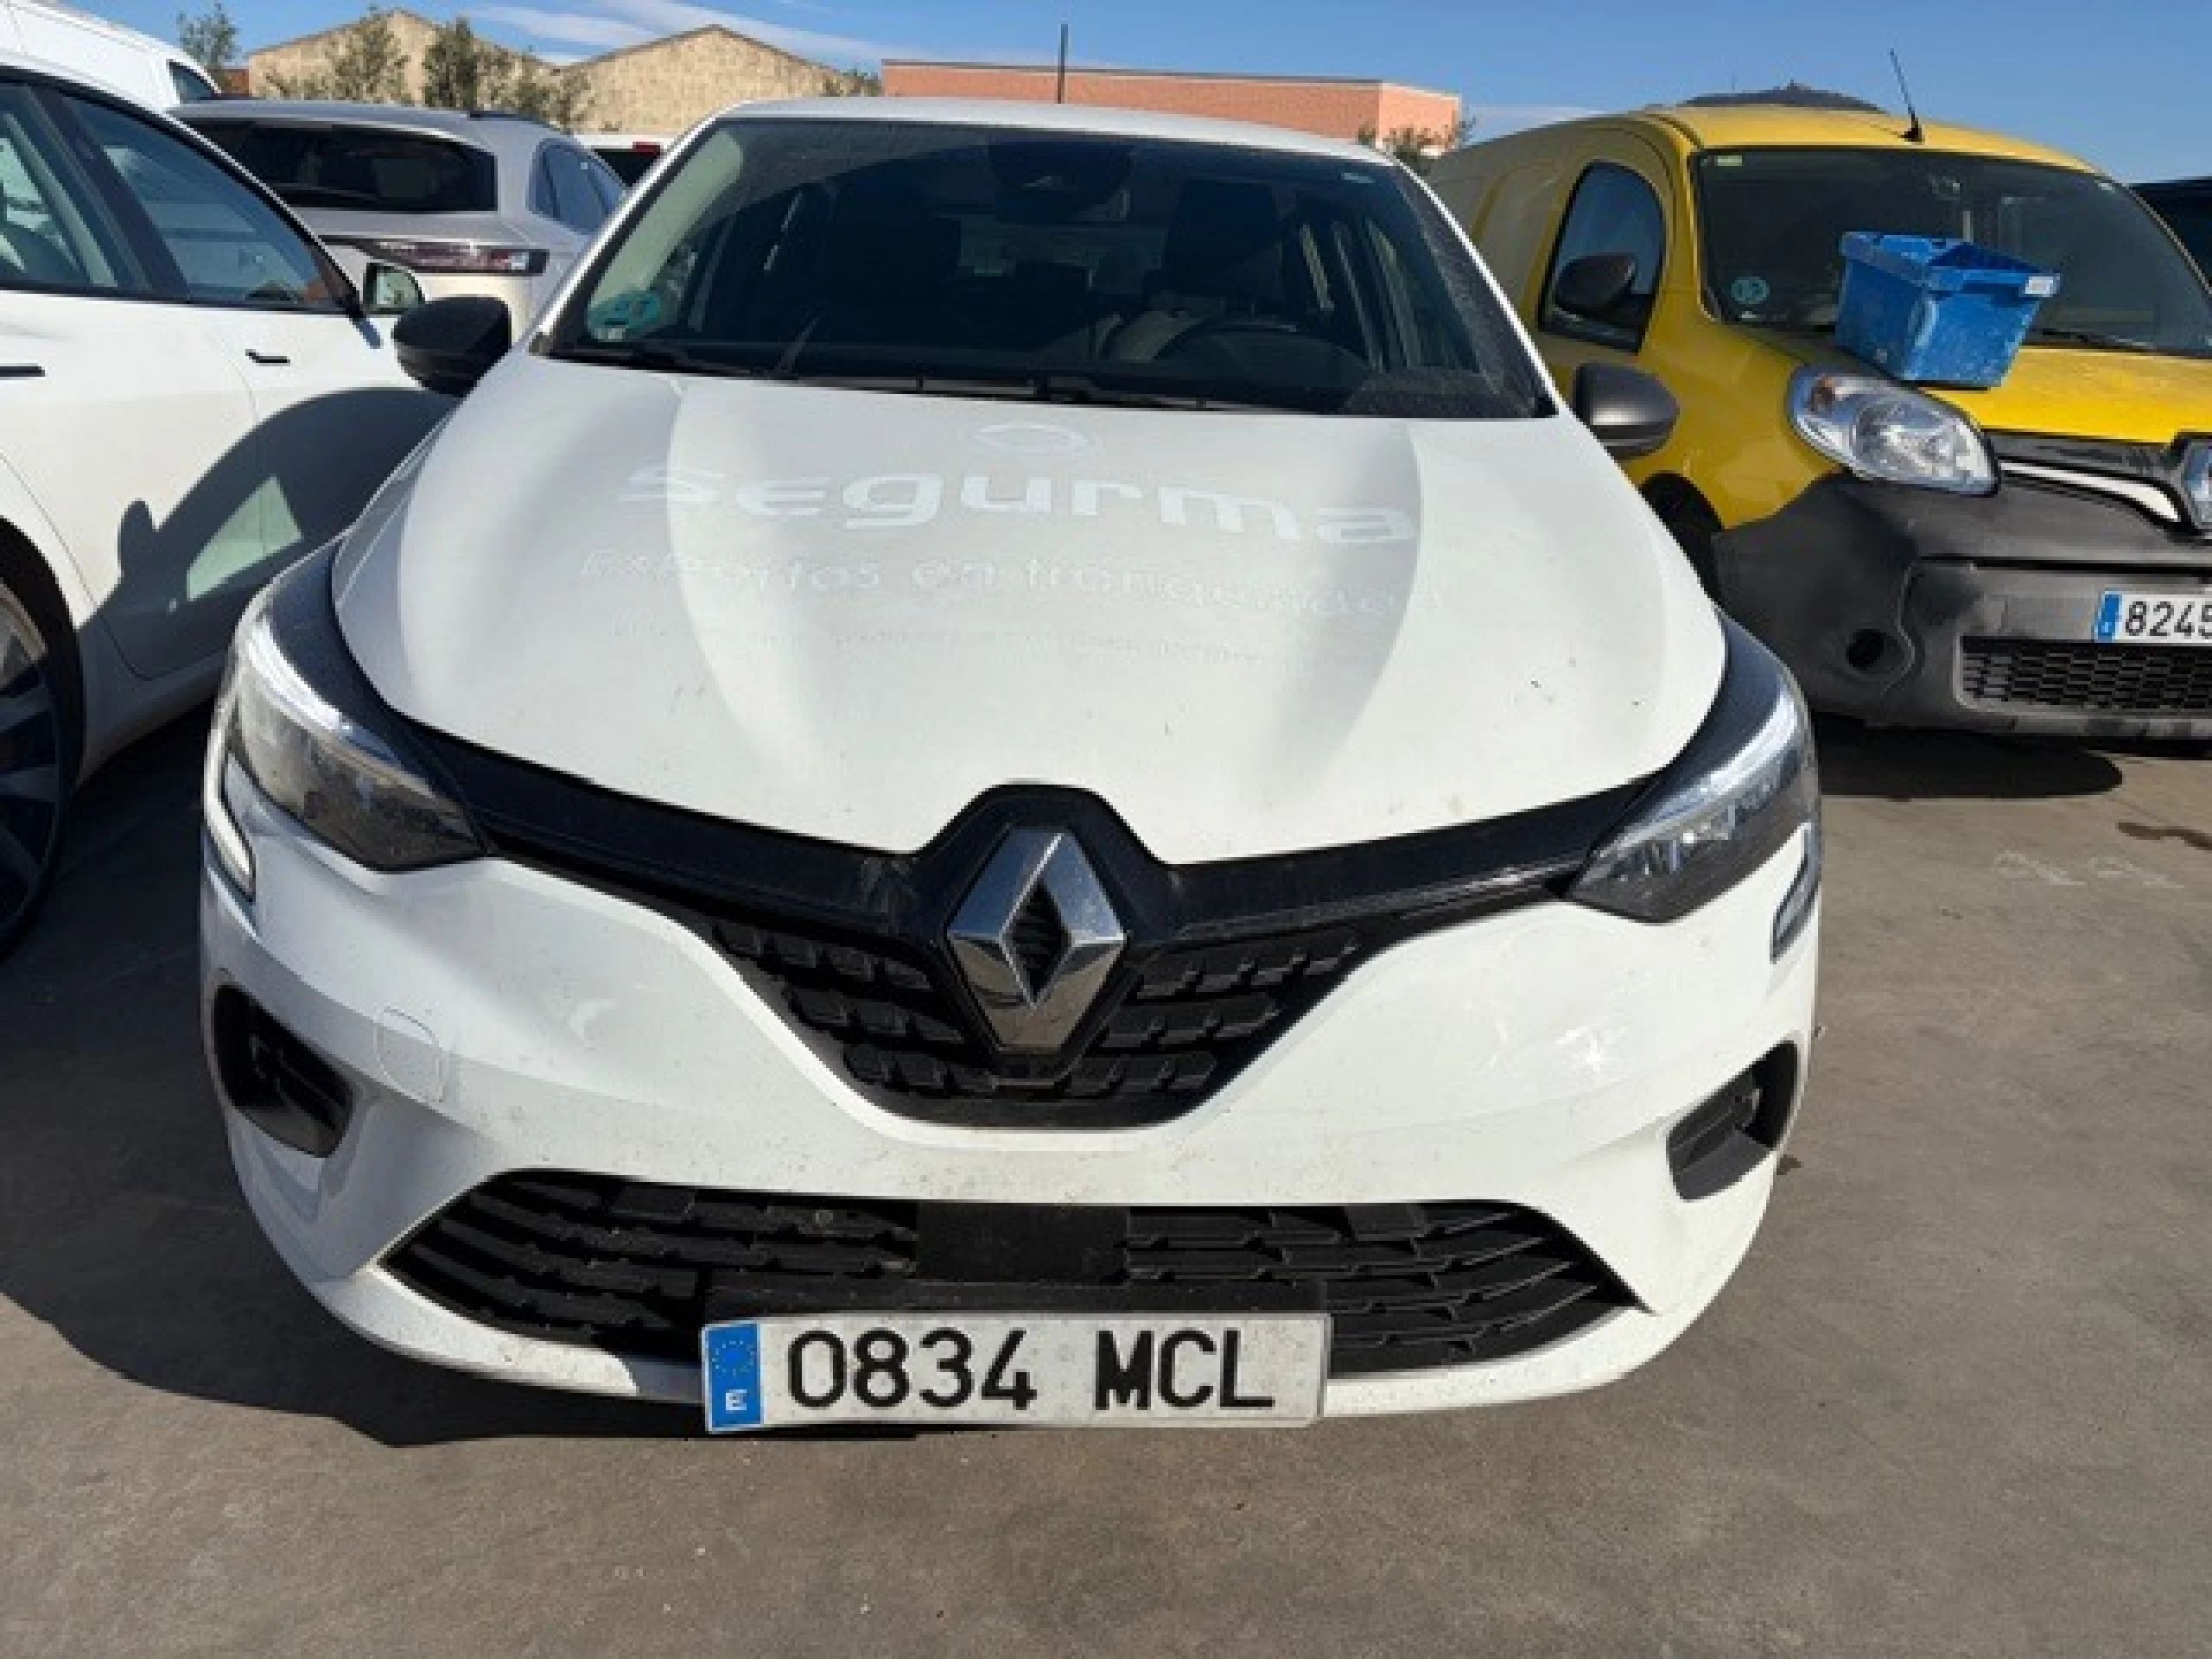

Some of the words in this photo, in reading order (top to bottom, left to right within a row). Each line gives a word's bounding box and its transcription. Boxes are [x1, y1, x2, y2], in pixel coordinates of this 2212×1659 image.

[787, 1328, 1037, 1410] 0834
[1094, 1329, 1276, 1410] MCL
[726, 1389, 747, 1410] E
